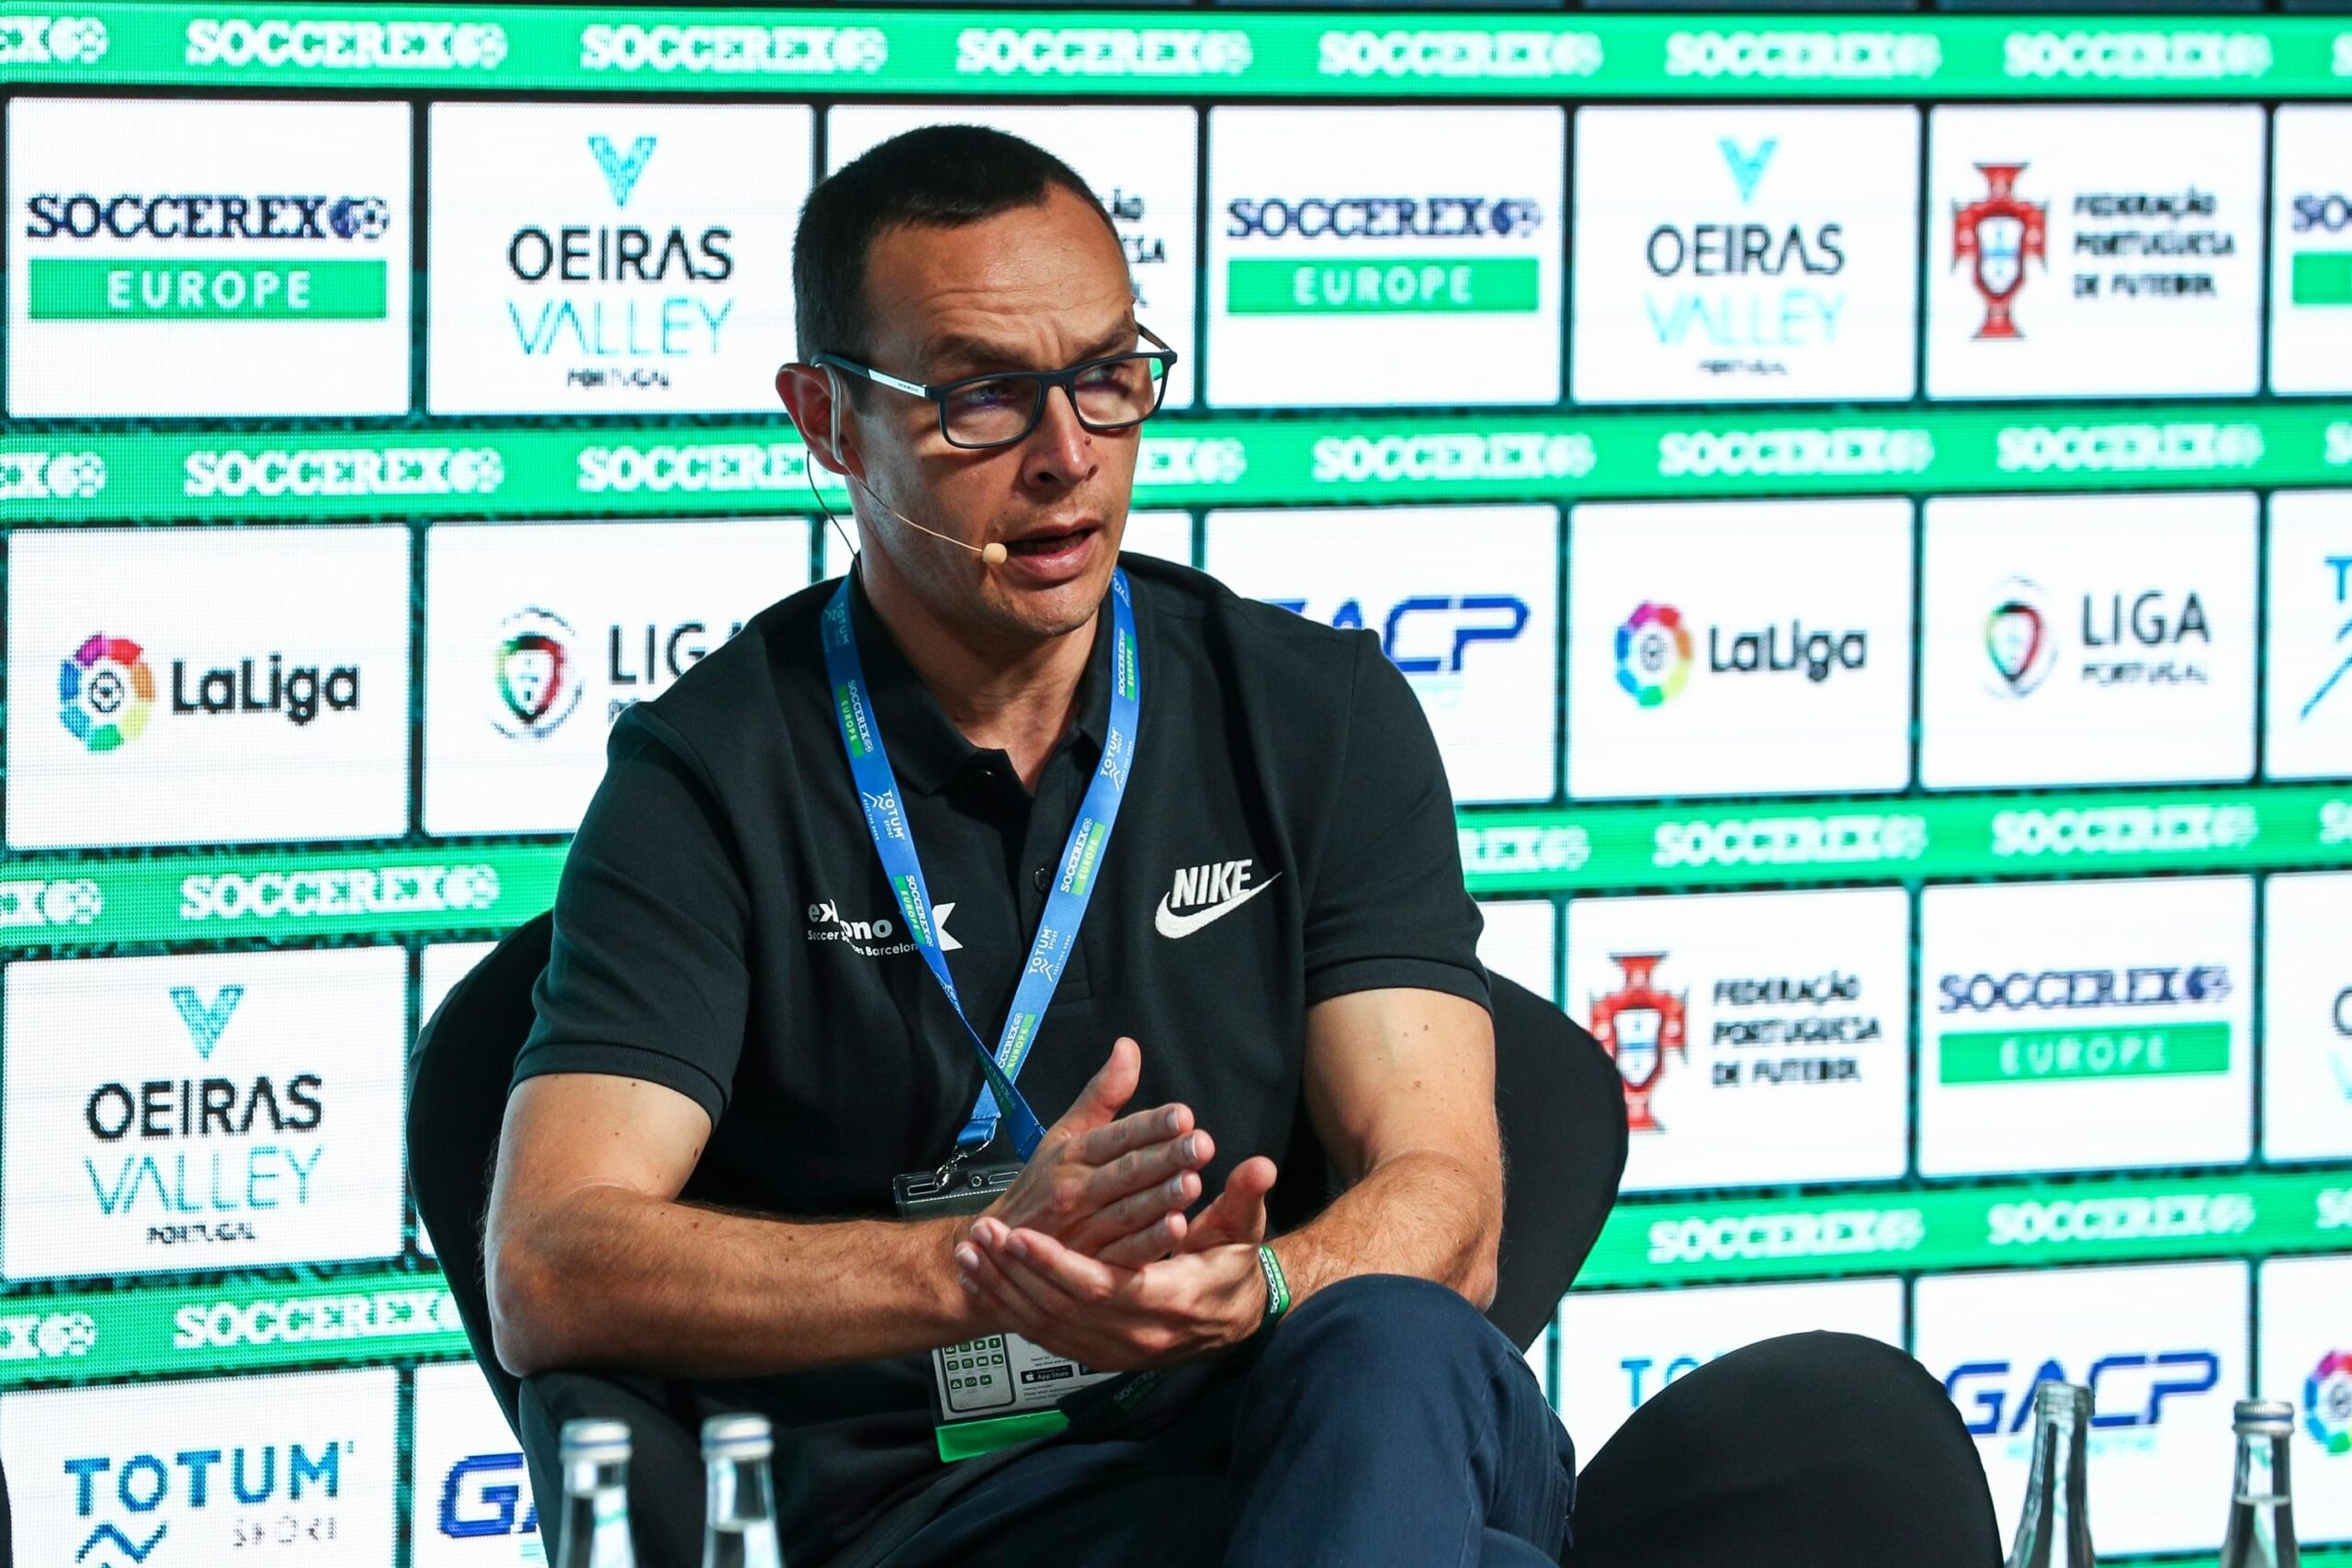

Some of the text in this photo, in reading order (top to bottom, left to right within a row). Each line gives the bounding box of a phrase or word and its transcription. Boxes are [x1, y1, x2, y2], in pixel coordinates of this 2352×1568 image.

[187, 19, 454, 69] SOCCEREX
[581, 24, 832, 73] SOCCEREX
[26, 194, 329, 241] SOCCEREX
[1227, 197, 1487, 239] SOCCEREX
[508, 226, 734, 283] OEIRAS
[1645, 223, 1846, 277] OEIRAS
[107, 269, 312, 310] EUROPE
[1294, 265, 1473, 306] EUROPE
[506, 298, 734, 356] VALLEY
[1644, 289, 1846, 346] VALLEY
[185, 447, 450, 498] SOCCEREX
[2082, 591, 2211, 647] LIGA
[608, 622, 746, 684] LIG
[1710, 619, 1868, 682] LaLiga
[172, 651, 360, 727] LaLiga
[847, 679, 870, 742] SOCCEREX
[841, 700, 857, 742] EUROPE
[1100, 728, 1118, 776] TOTUM
[883, 788, 904, 840] TOTUM
[1061, 829, 1089, 893] SOCCEREX
[1171, 859, 1253, 908] NIKE
[181, 866, 446, 920] SOCCEREX
[865, 942, 919, 956] Barcelon
[1029, 927, 1053, 975] TOTUM
[997, 1021, 1019, 1069] CCEREX
[1999, 1034, 2168, 1077] EUROPE
[85, 1073, 323, 1141] OEIRAS
[85, 1144, 323, 1214] VALLEY
[174, 1292, 439, 1350] SOCCEREX
[63, 1441, 340, 1517] TOTUM
